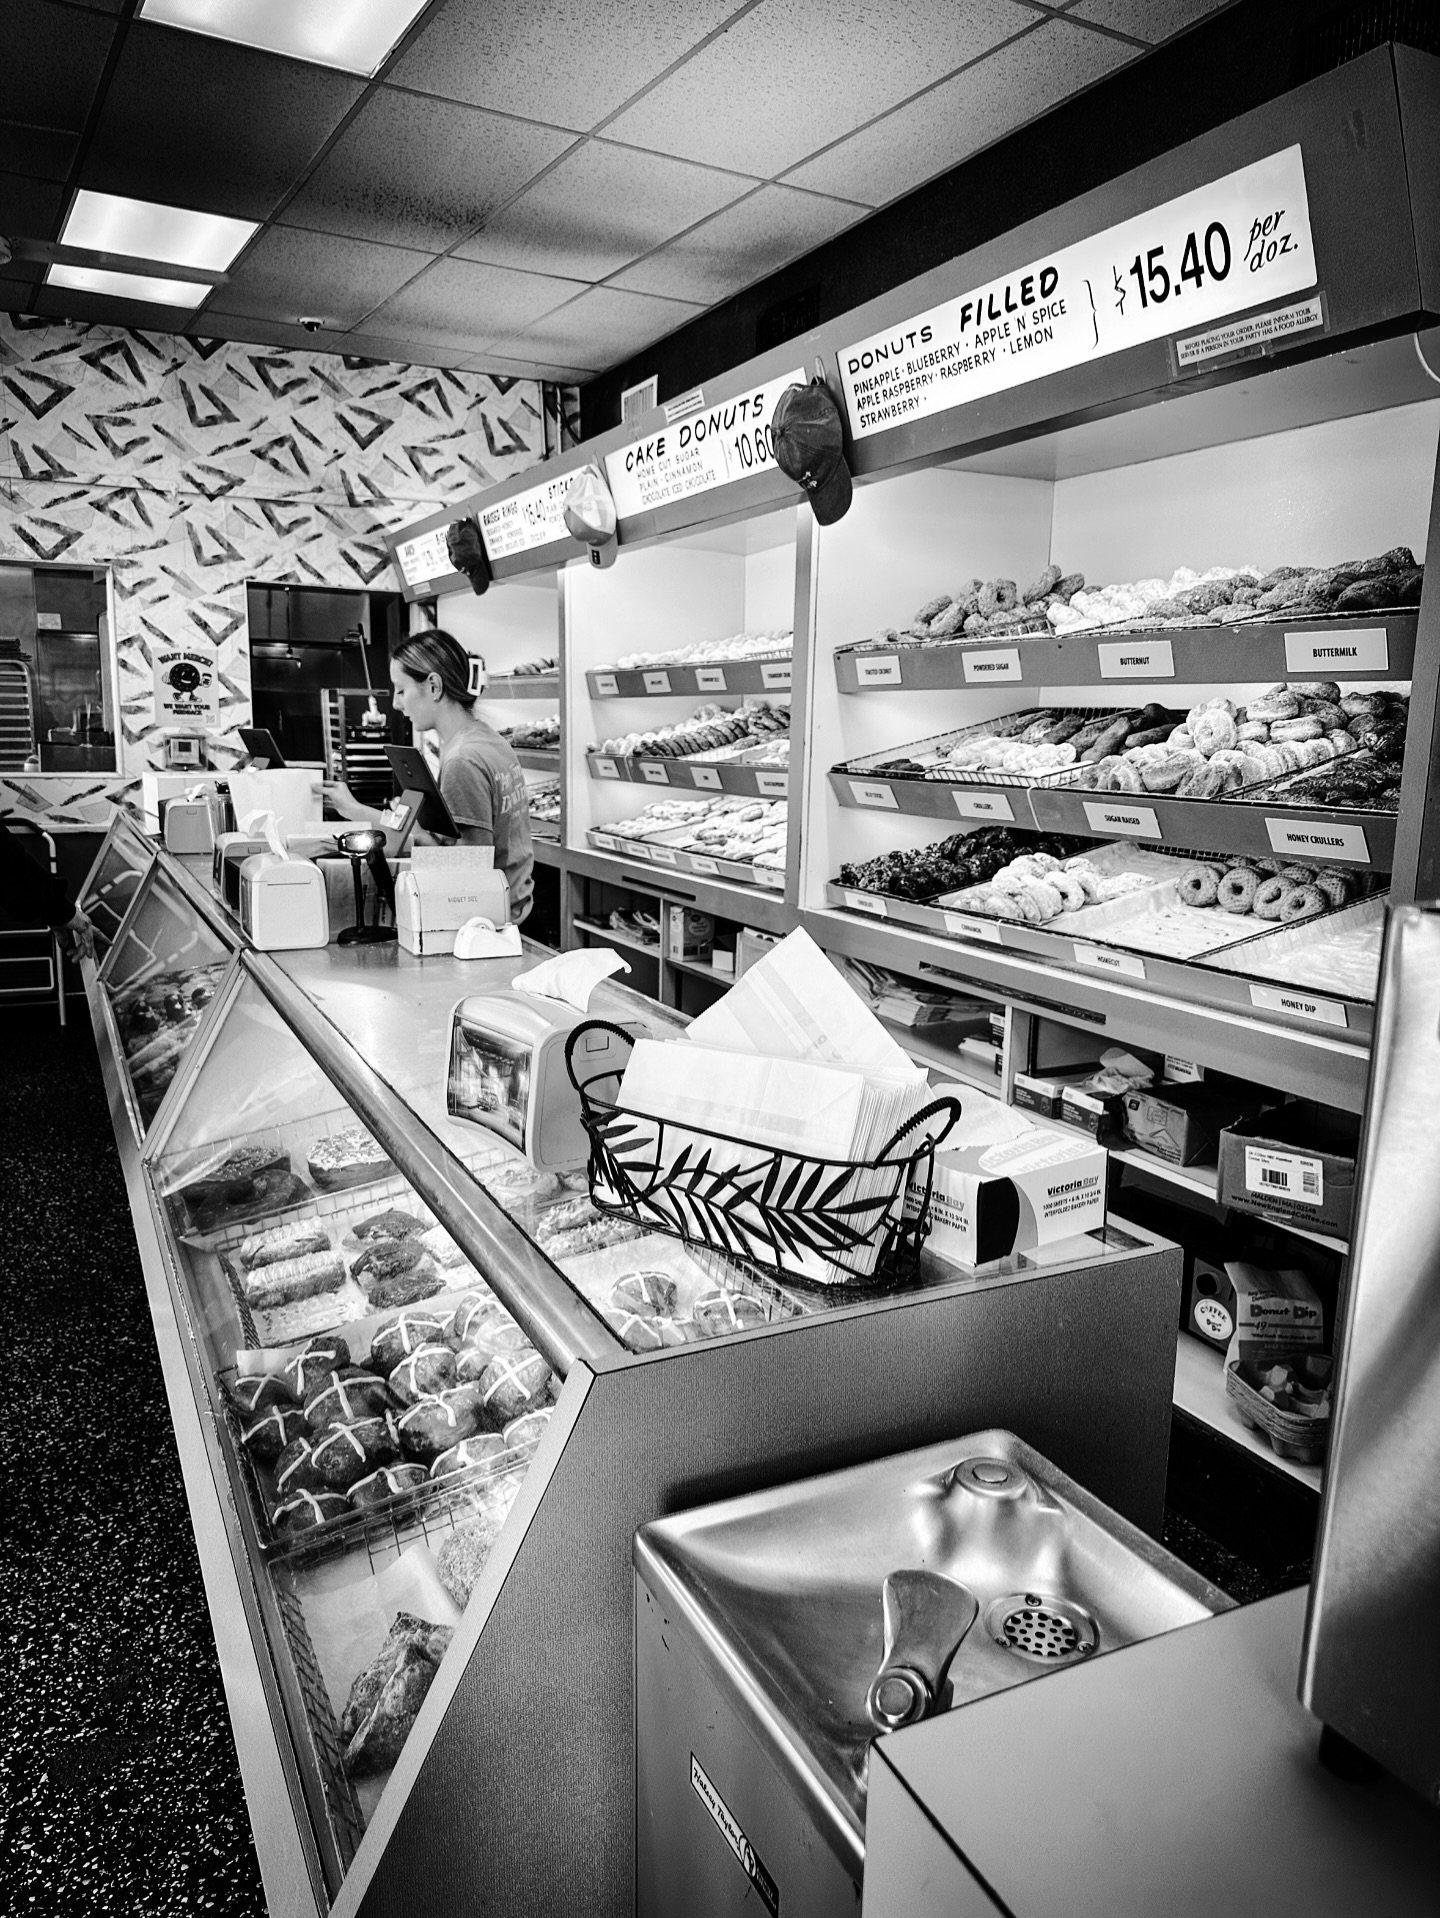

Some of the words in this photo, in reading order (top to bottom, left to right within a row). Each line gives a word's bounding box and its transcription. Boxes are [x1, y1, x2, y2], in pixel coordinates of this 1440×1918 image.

[1243, 210, 1285, 261] per
[1249, 233, 1299, 272] doz.
[847, 325, 933, 375] DONUTS
[960, 266, 1059, 332] FILLED
[853, 369, 901, 397] PINEAPPLE
[907, 341, 961, 375] BLUEBERRY
[975, 321, 1010, 348] APPLE
[1033, 299, 1067, 325] SPICE
[856, 394, 880, 412] APPLE
[882, 373, 934, 402] RASPBERRY
[940, 347, 996, 380] RASPBERRY
[1010, 326, 1054, 355] LEMON
[860, 395, 920, 429] STRAWBERRY
[626, 437, 665, 472] CAKE
[680, 393, 764, 448] DONUTS
[665, 459, 703, 482] CINNAMON
[1119, 655, 1150, 666] BUTTERNUT
[1312, 647, 1358, 658] BUTTERMILK
[1105, 814, 1121, 823] SUGAR
[1286, 833, 1309, 844] HONEY
[1310, 835, 1345, 847] CRULLERS
[1281, 999, 1304, 1010] HONEY
[1304, 1004, 1317, 1013] DIP
[1047, 1180, 1082, 1195] Victoria
[1083, 1175, 1099, 1190] Bay
[1044, 1206, 1070, 1218] INTERFOLDED
[1071, 1201, 1086, 1210] BAKERY
[1087, 1197, 1099, 1206] PAPER
[1053, 1199, 1068, 1208] SHEETS
[1231, 1195, 1339, 1229] www.NewEnglandCoffee.com
[934, 1213, 951, 1226] BAKERY
[952, 1220, 967, 1232] PAPER
[1250, 1304, 1290, 1318] Donut
[1293, 1305, 1318, 1319] Dip
[694, 1767, 716, 1809] Halsey
[717, 1804, 740, 1851] Taylor
